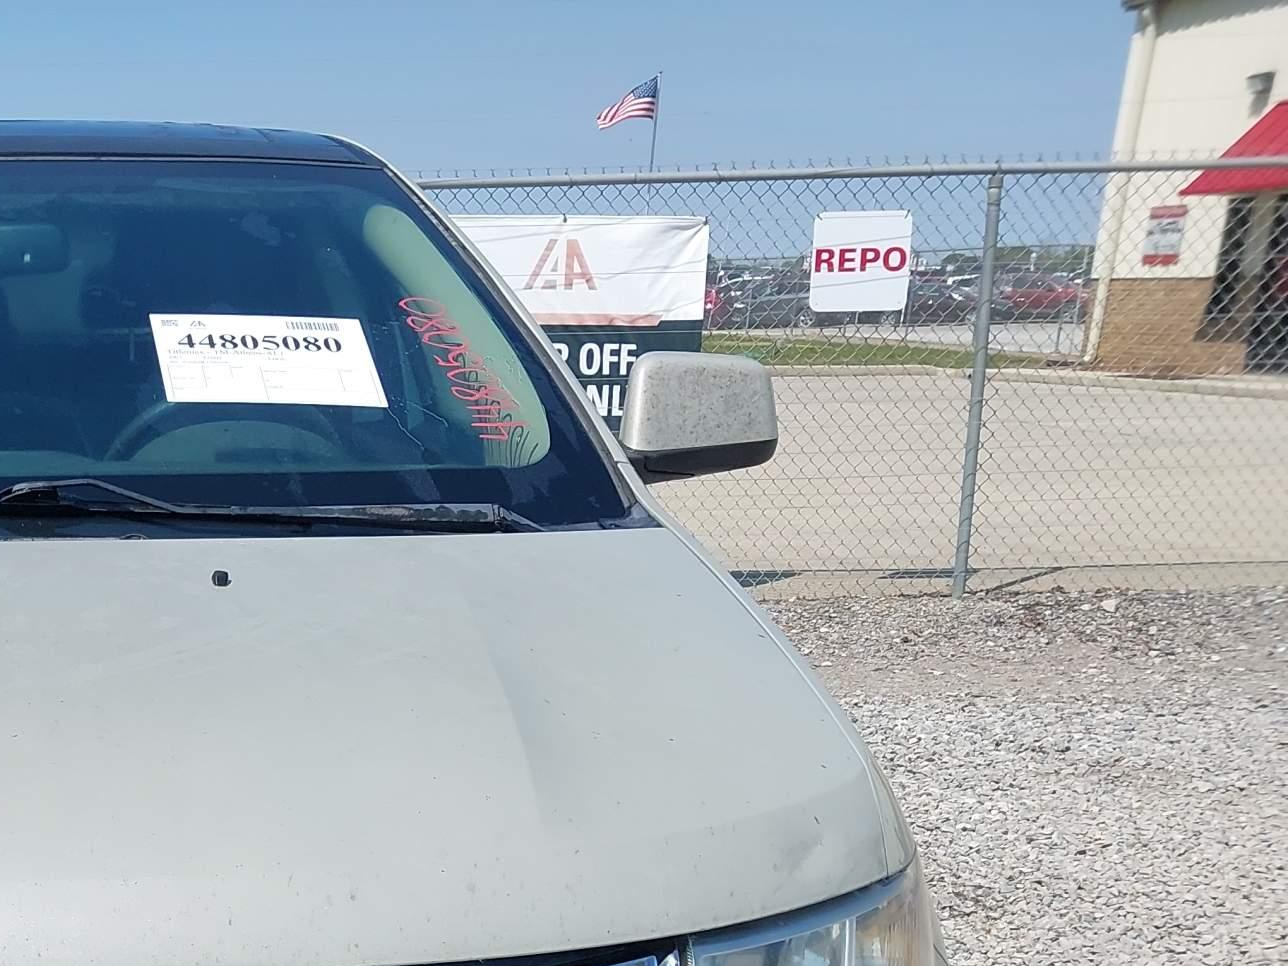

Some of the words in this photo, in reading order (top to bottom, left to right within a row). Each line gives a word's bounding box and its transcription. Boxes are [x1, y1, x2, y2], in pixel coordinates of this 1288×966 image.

[814, 247, 907, 272] REPO
[177, 333, 342, 353] 44805080
[579, 343, 638, 375] OFF
